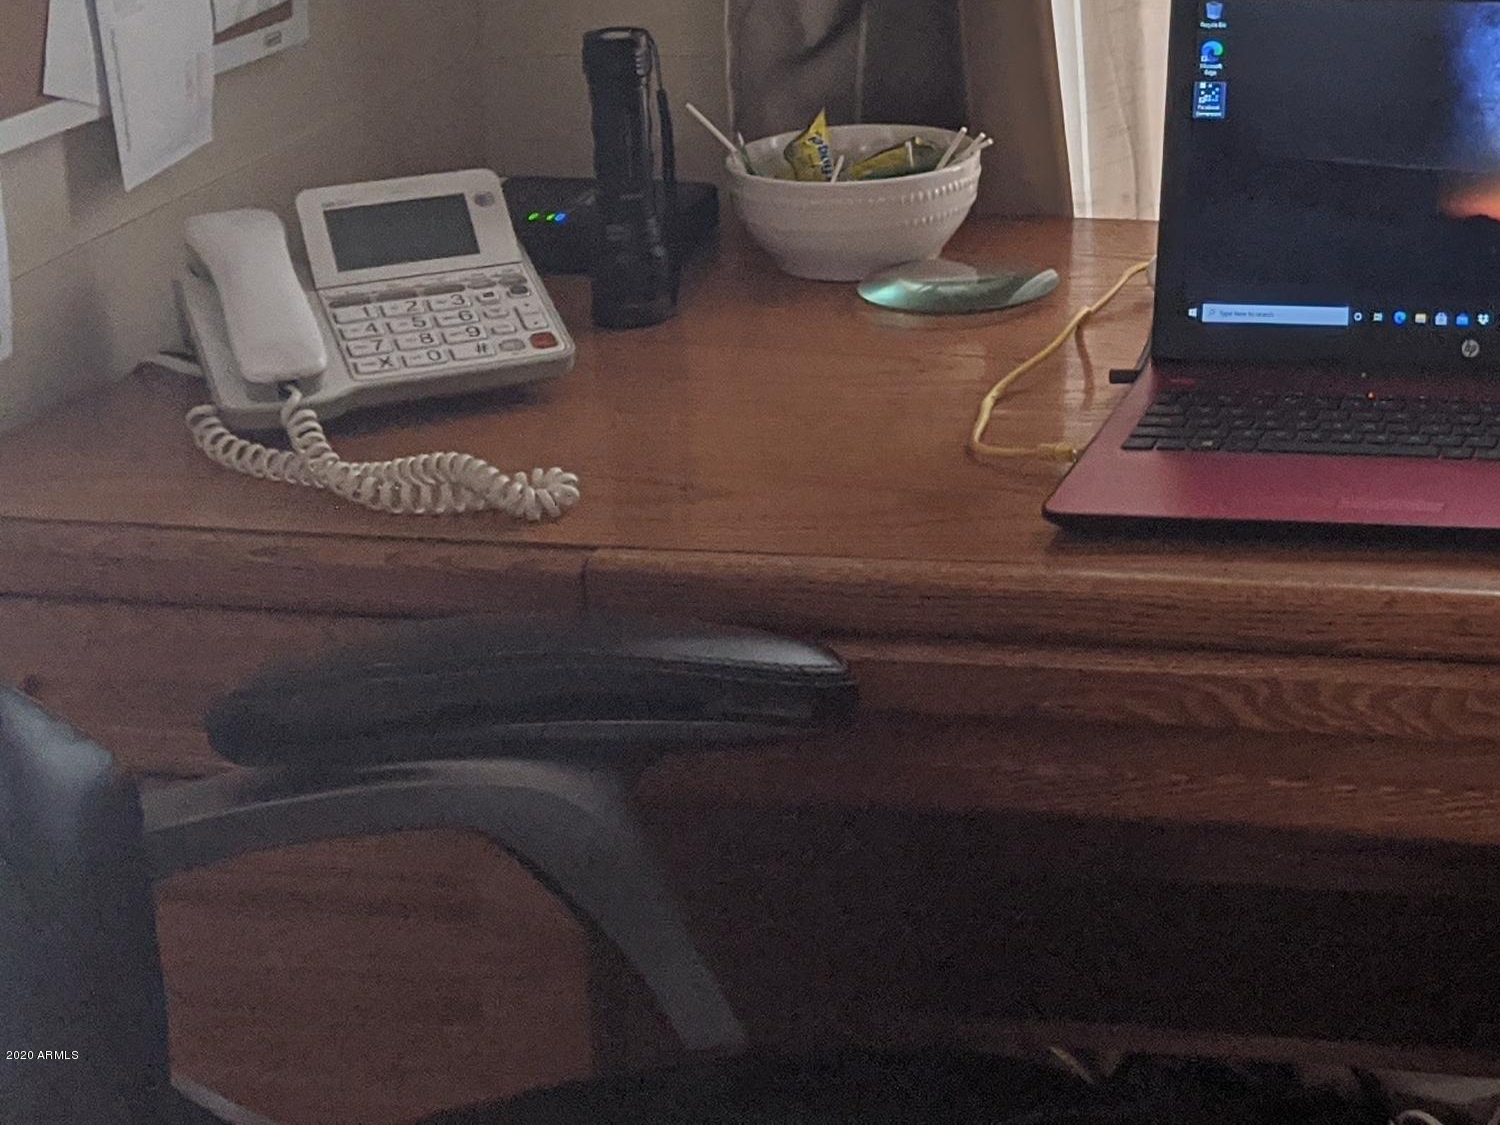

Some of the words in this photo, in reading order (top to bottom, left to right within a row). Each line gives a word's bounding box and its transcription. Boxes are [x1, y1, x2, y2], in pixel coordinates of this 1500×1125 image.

[405, 300, 417, 312] 2
[450, 294, 465, 306] 3
[366, 322, 378, 333] 4
[412, 316, 426, 328] 5
[458, 310, 473, 321] 6
[371, 339, 383, 351] 7
[419, 332, 434, 344] 8
[465, 326, 480, 338] 9
[1461, 339, 1480, 358] hp
